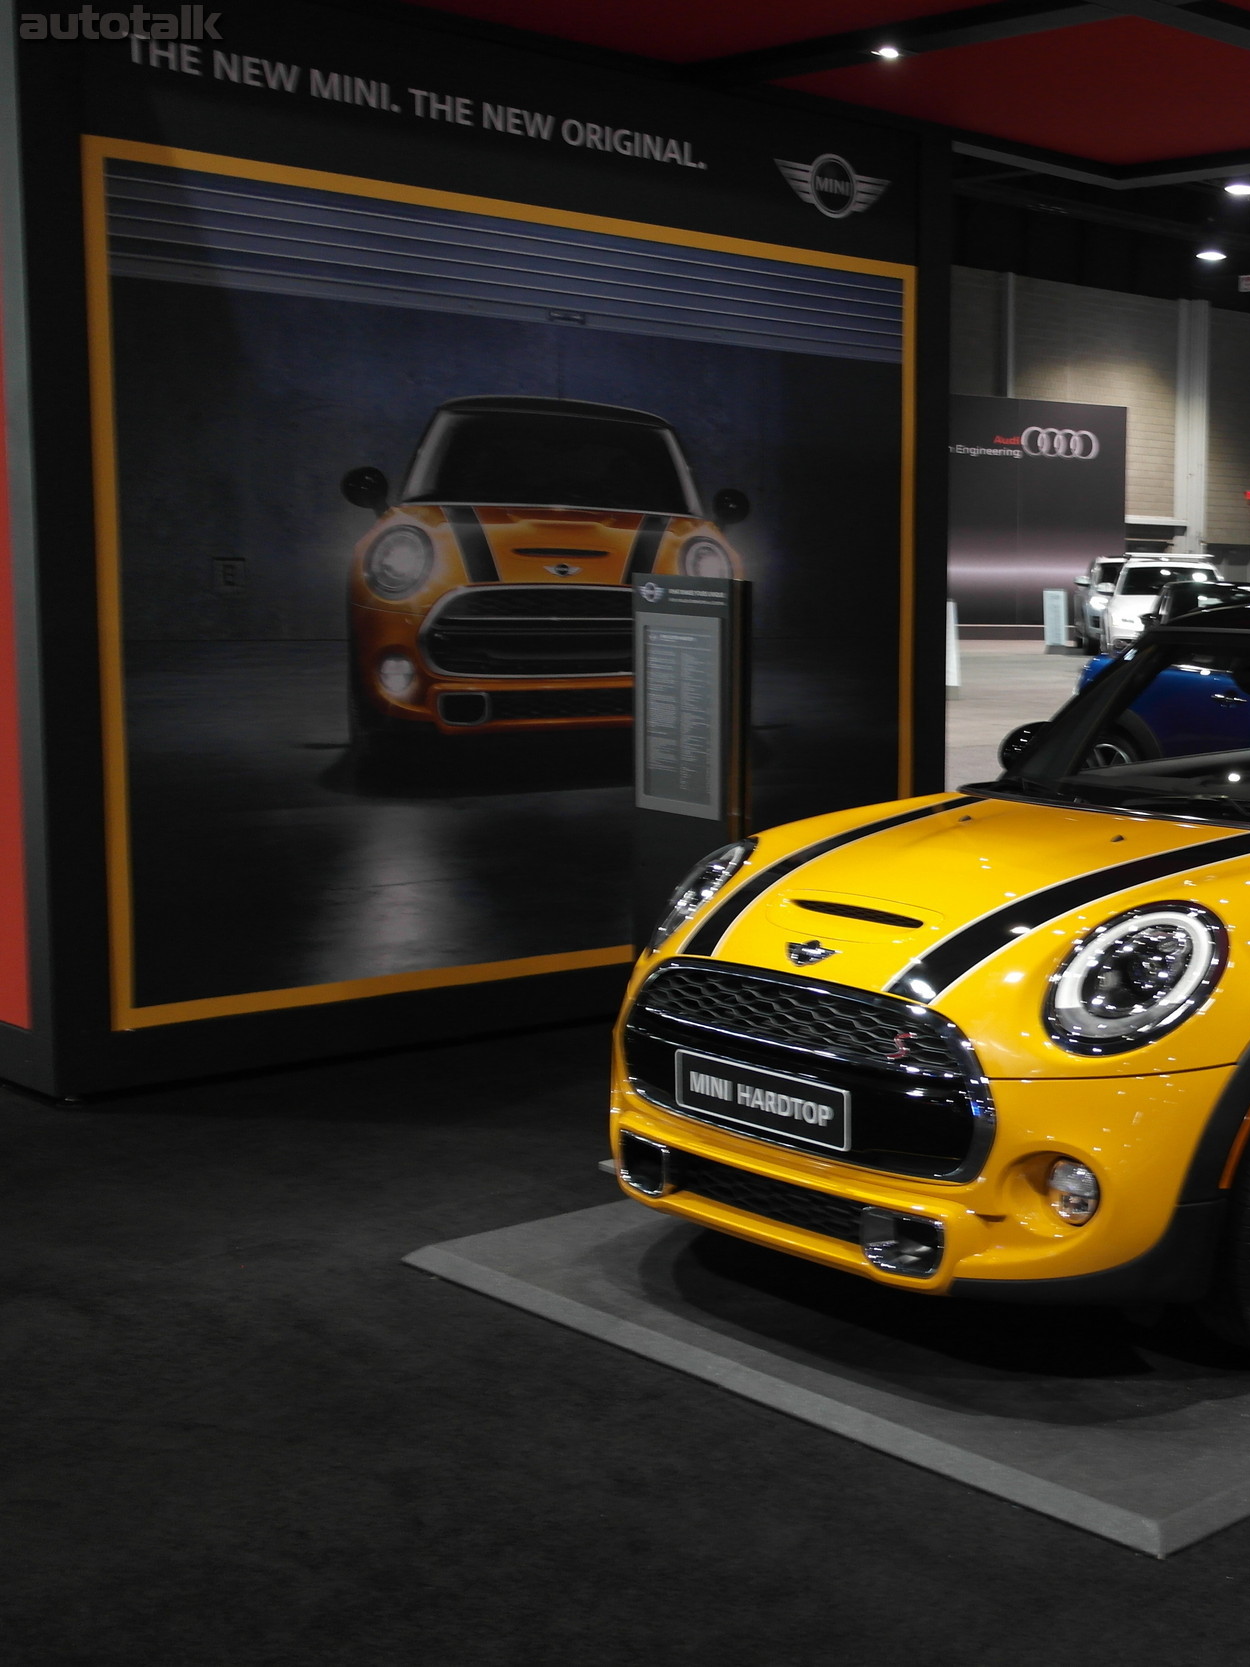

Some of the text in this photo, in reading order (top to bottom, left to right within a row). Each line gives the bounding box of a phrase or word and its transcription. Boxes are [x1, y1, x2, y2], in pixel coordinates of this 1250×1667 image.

[123, 31, 708, 170] THE NEW MINI. THE NEW ORIGINAL.
[815, 175, 851, 197] MINI
[956, 445, 1023, 458] Engineering
[994, 436, 1022, 446] Audi
[689, 1071, 835, 1127] MINI HARDTOP
